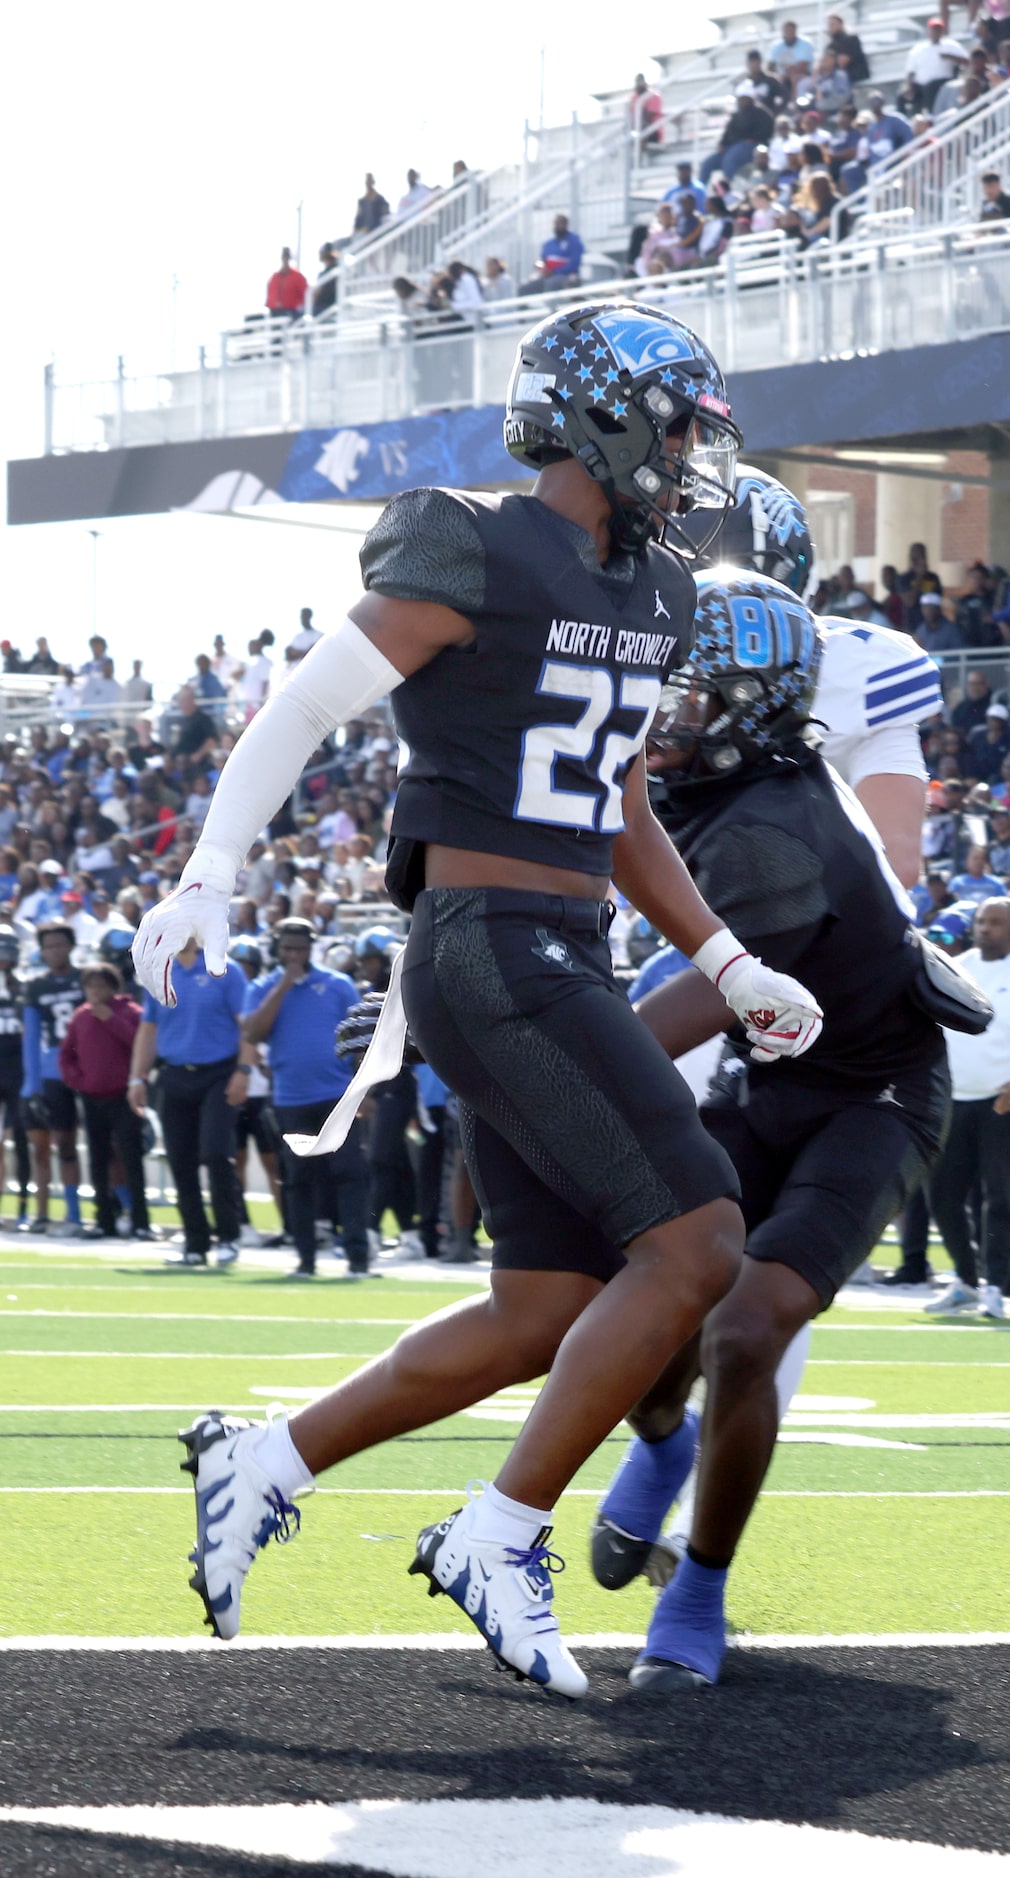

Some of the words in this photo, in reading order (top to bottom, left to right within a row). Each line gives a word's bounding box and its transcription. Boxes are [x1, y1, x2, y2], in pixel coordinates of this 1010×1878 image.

[546, 619, 612, 659] NORTH
[614, 629, 679, 667] CROWLEY
[728, 595, 816, 676] 817
[512, 657, 663, 834] 22
